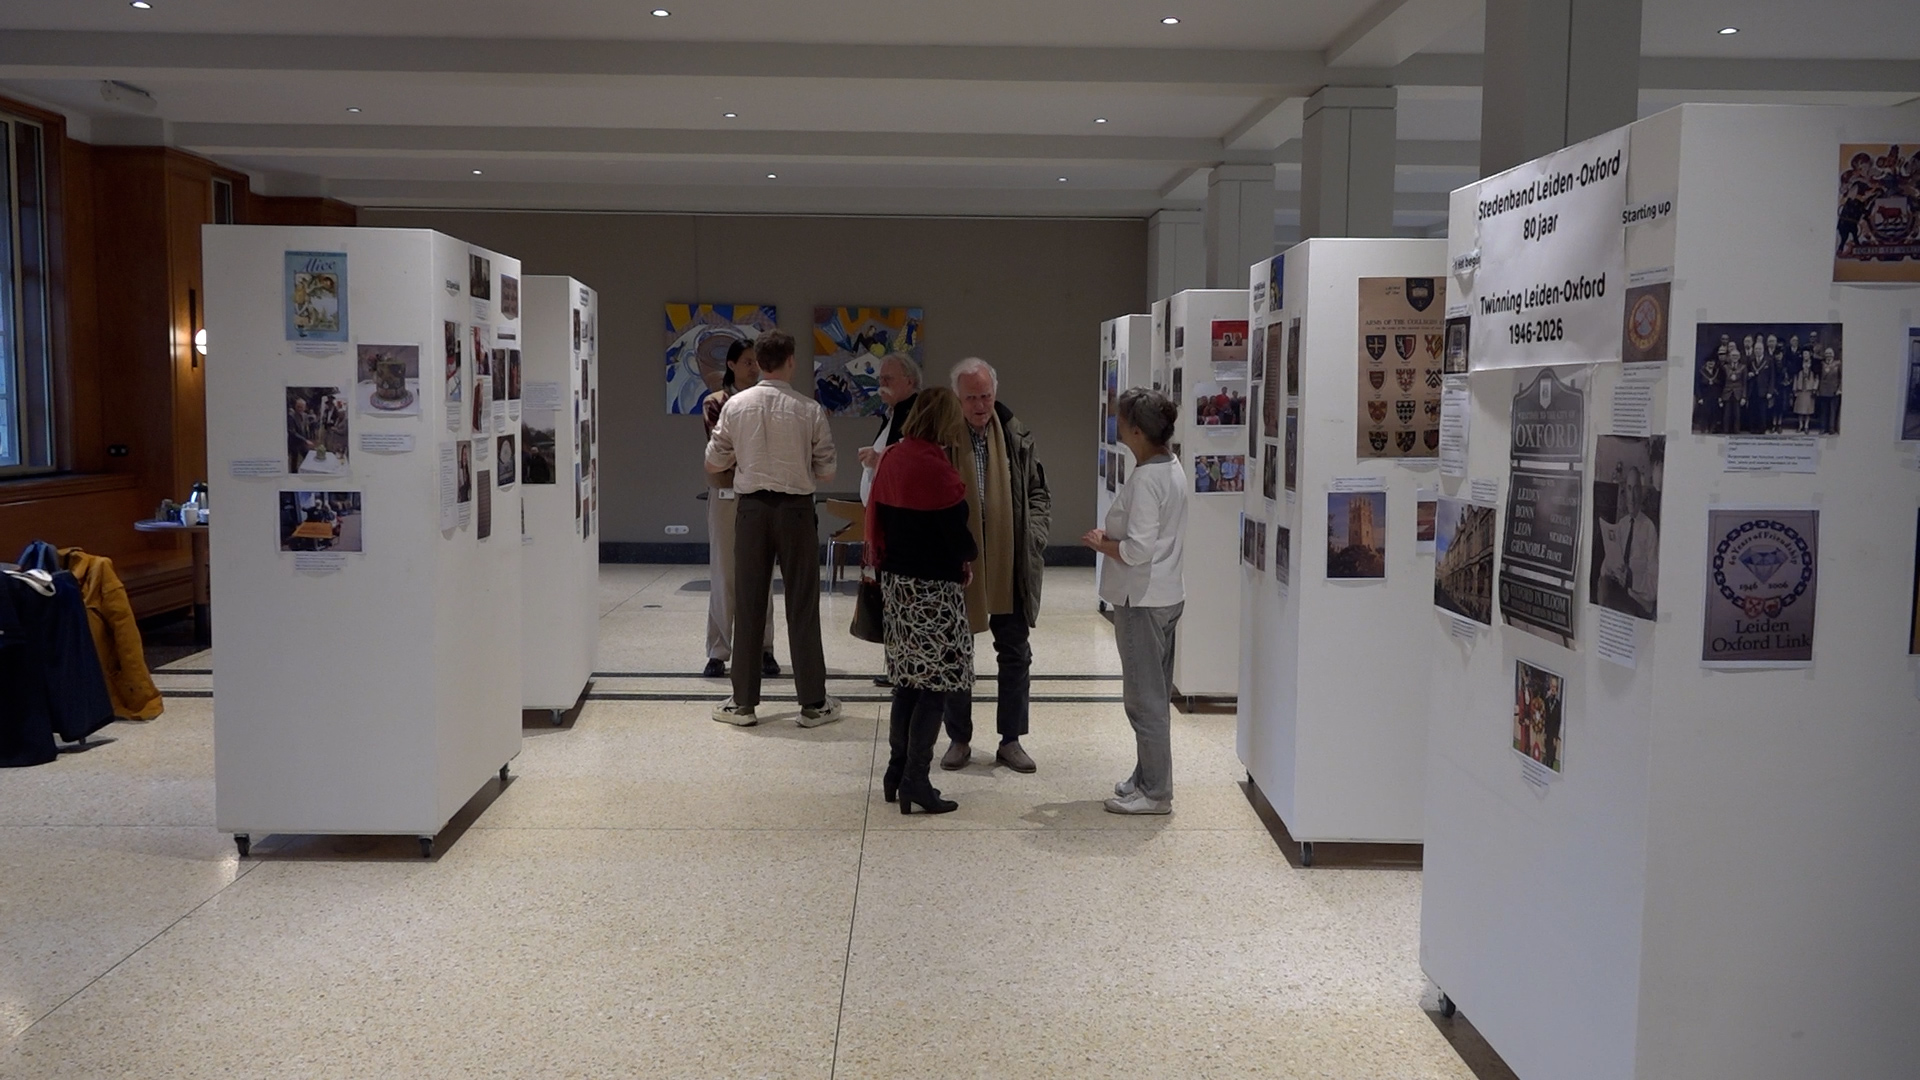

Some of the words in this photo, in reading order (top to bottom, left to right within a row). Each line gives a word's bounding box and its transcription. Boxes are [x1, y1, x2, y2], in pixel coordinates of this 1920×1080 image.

[1478, 181, 1535, 220] Stedenband
[1536, 172, 1573, 201] Leiden
[1622, 205, 1657, 224] Starting
[1657, 201, 1671, 217] up
[1523, 217, 1536, 240] 80
[1536, 213, 1558, 242] jaar
[1480, 289, 1522, 315] Twinning
[1524, 272, 1606, 309] Leiden-Oxford
[1509, 318, 1563, 344] 1946-2026
[1515, 423, 1578, 448] OXFORD
[1513, 522, 1532, 536] LEON
[1510, 540, 1547, 558] GRENOBLE
[1731, 537, 1751, 554] Years
[1753, 531, 1762, 539] of
[1763, 532, 1798, 565] Friendship
[1739, 581, 1758, 591] 1946
[1768, 581, 1789, 589] 2006
[1735, 619, 1790, 634] Leiden
[1712, 635, 1770, 652] Oxford
[1775, 633, 1811, 649] Link
